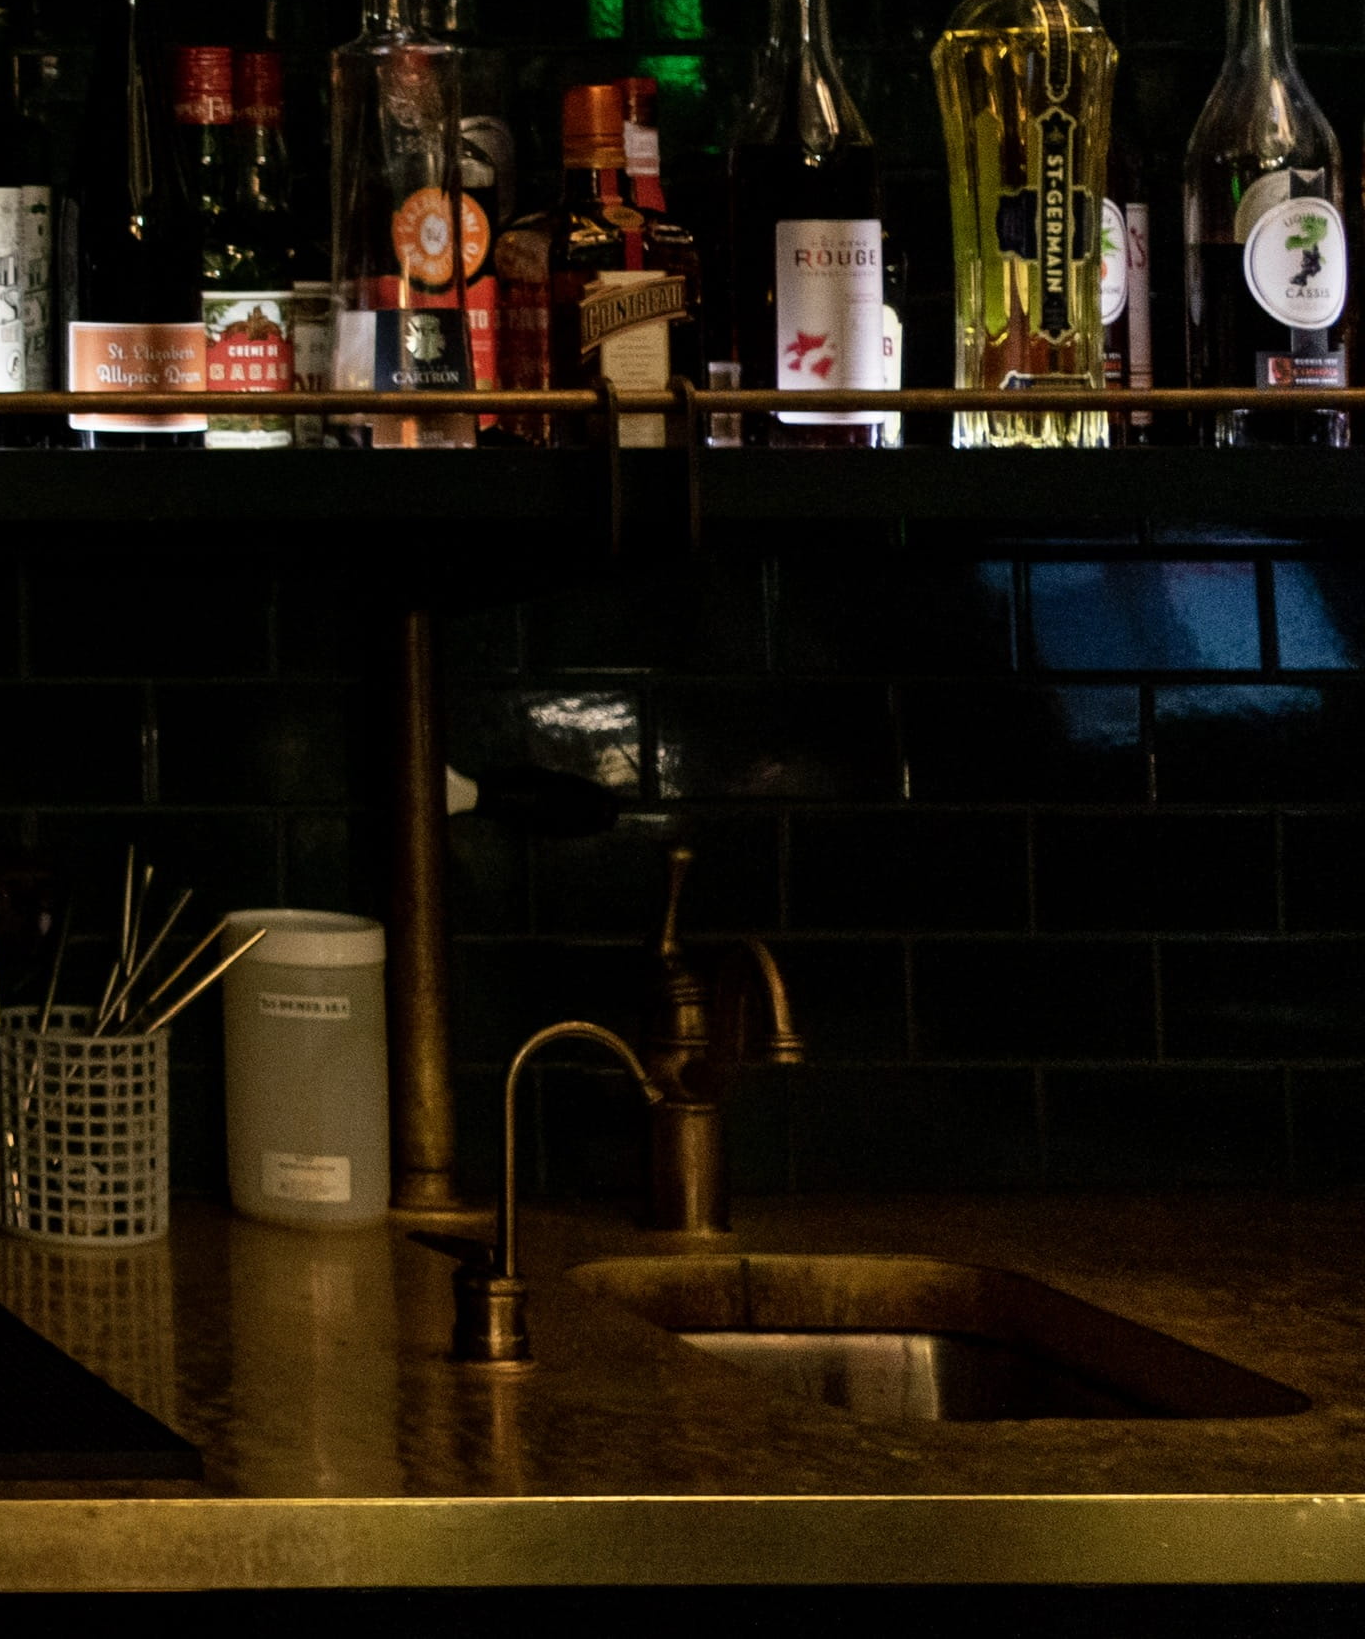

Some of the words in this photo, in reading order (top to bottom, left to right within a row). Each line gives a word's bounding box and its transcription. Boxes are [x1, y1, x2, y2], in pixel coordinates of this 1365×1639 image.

[1046, 154, 1064, 293] ST-GERMAIN
[1285, 288, 1331, 300] CASSIS
[585, 284, 685, 339] COINTREAU
[97, 365, 160, 386] Allspice
[392, 370, 459, 385] CARTRON
